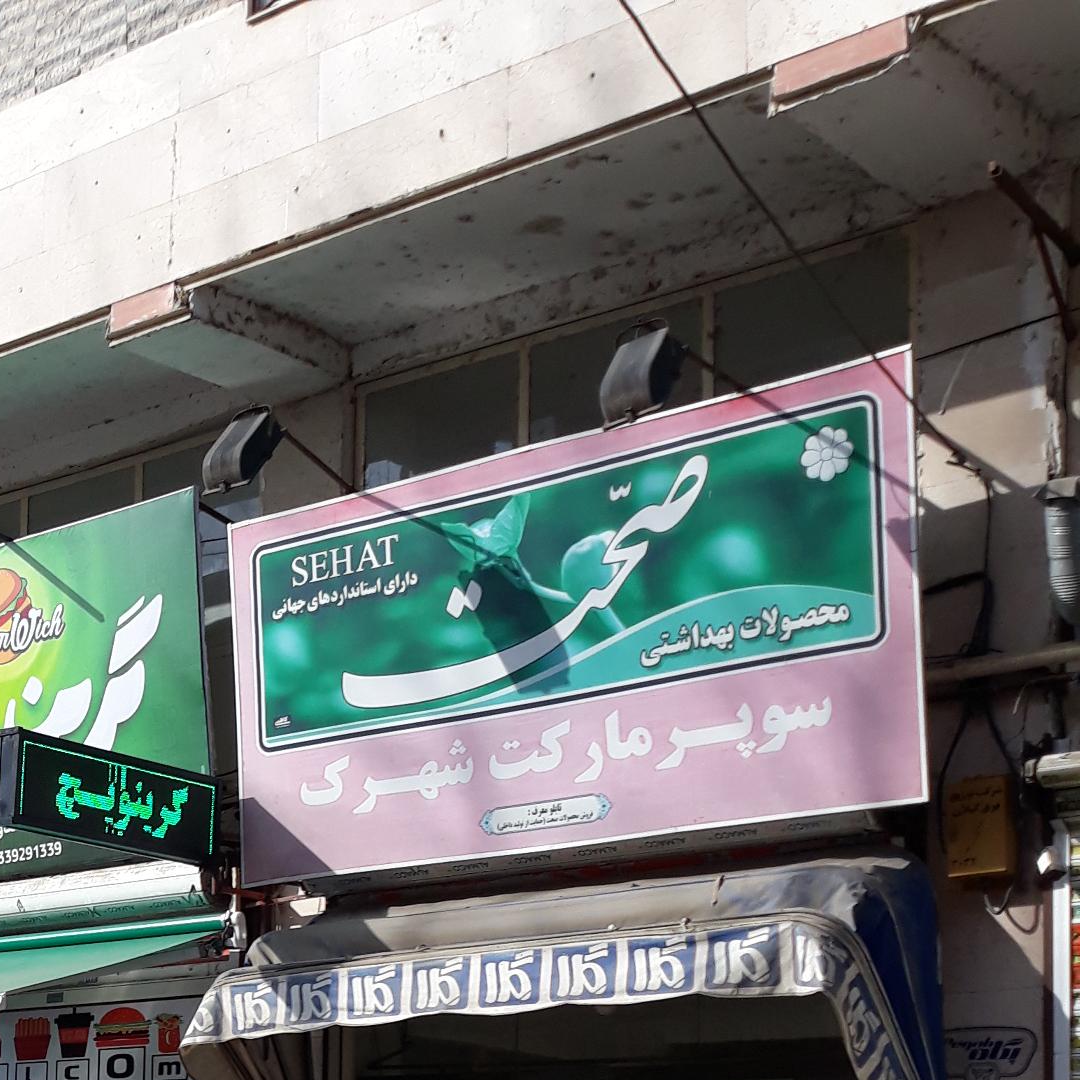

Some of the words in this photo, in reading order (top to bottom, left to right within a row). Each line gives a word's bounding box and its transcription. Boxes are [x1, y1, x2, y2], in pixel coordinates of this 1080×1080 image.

[291, 534, 399, 588] SEHAT
[383, 571, 418, 596] دارای
[272, 597, 306, 620] جهانی
[307, 577, 382, 612] استانداردهای
[639, 620, 735, 668] بهداشتی
[738, 602, 851, 643] محصولات
[487, 709, 654, 784] مارکت
[655, 695, 832, 771] سوپر
[299, 738, 476, 815] شهرک
